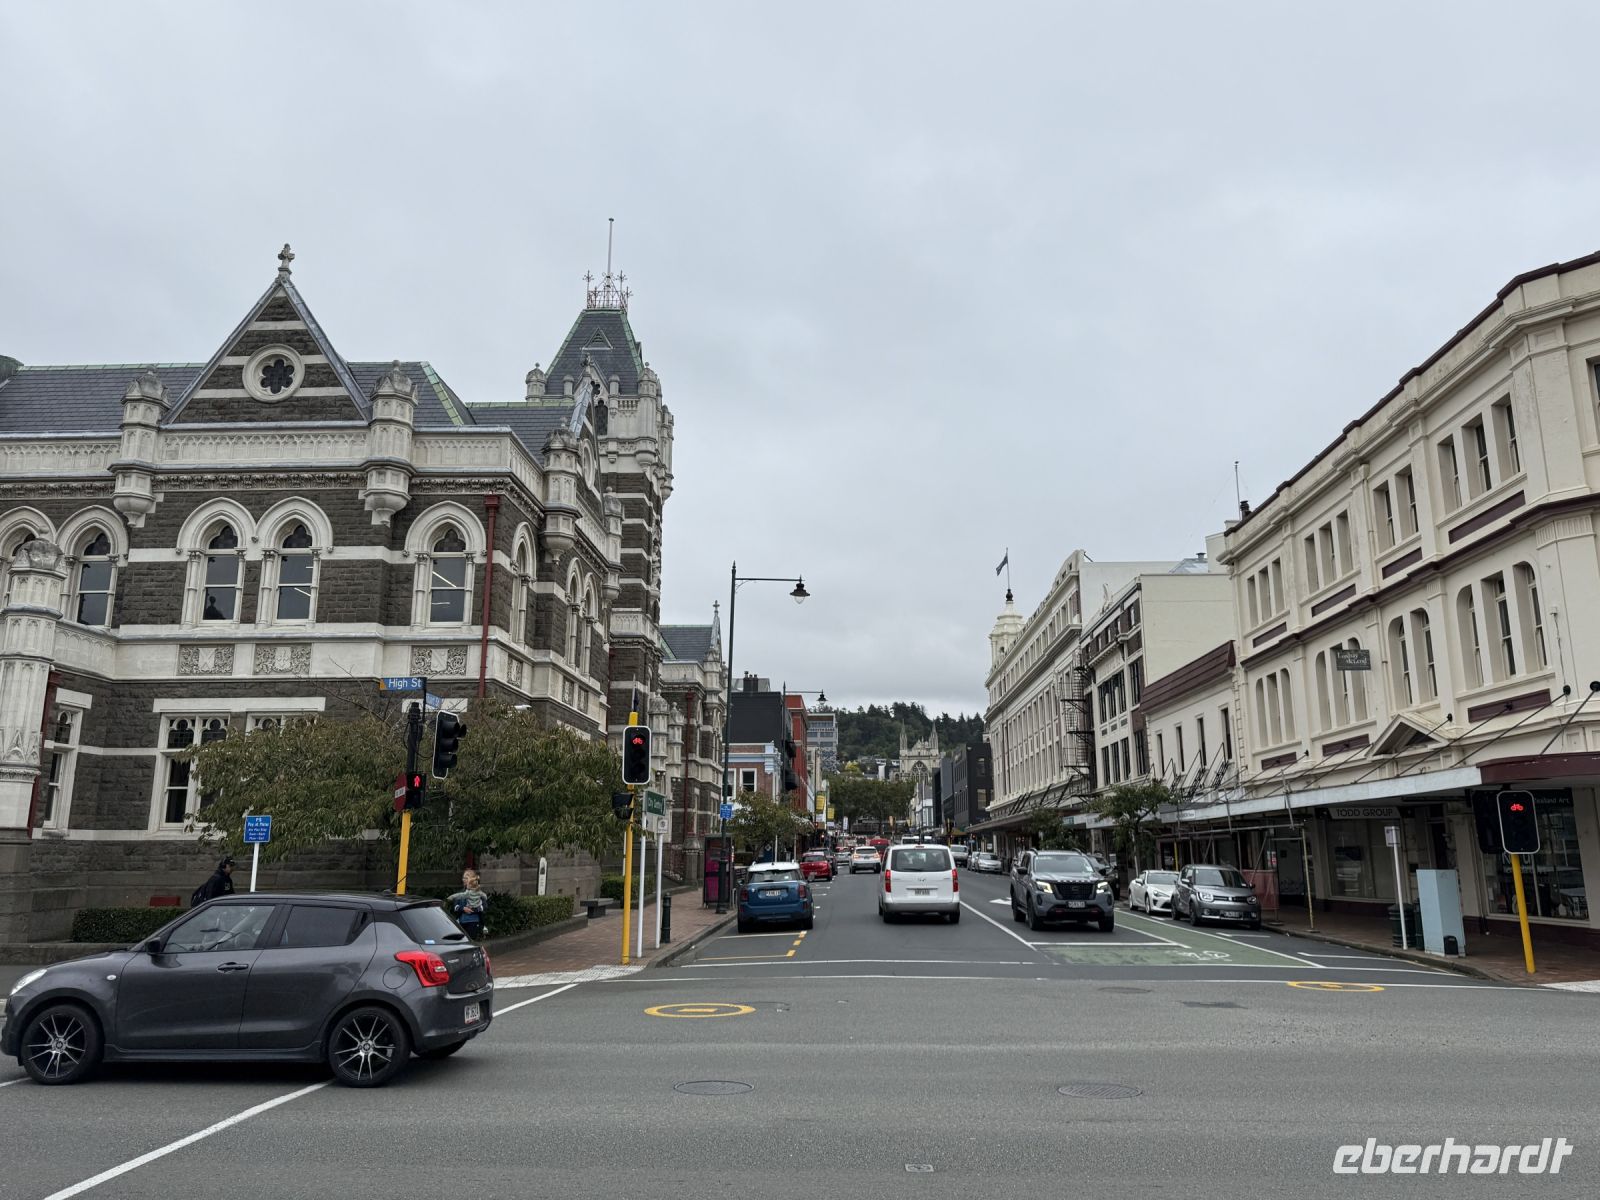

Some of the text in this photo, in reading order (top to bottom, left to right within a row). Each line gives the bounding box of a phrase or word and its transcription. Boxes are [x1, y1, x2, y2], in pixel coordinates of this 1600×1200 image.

[388, 678, 422, 690] High St
[1336, 808, 1393, 817] TODD GROUP
